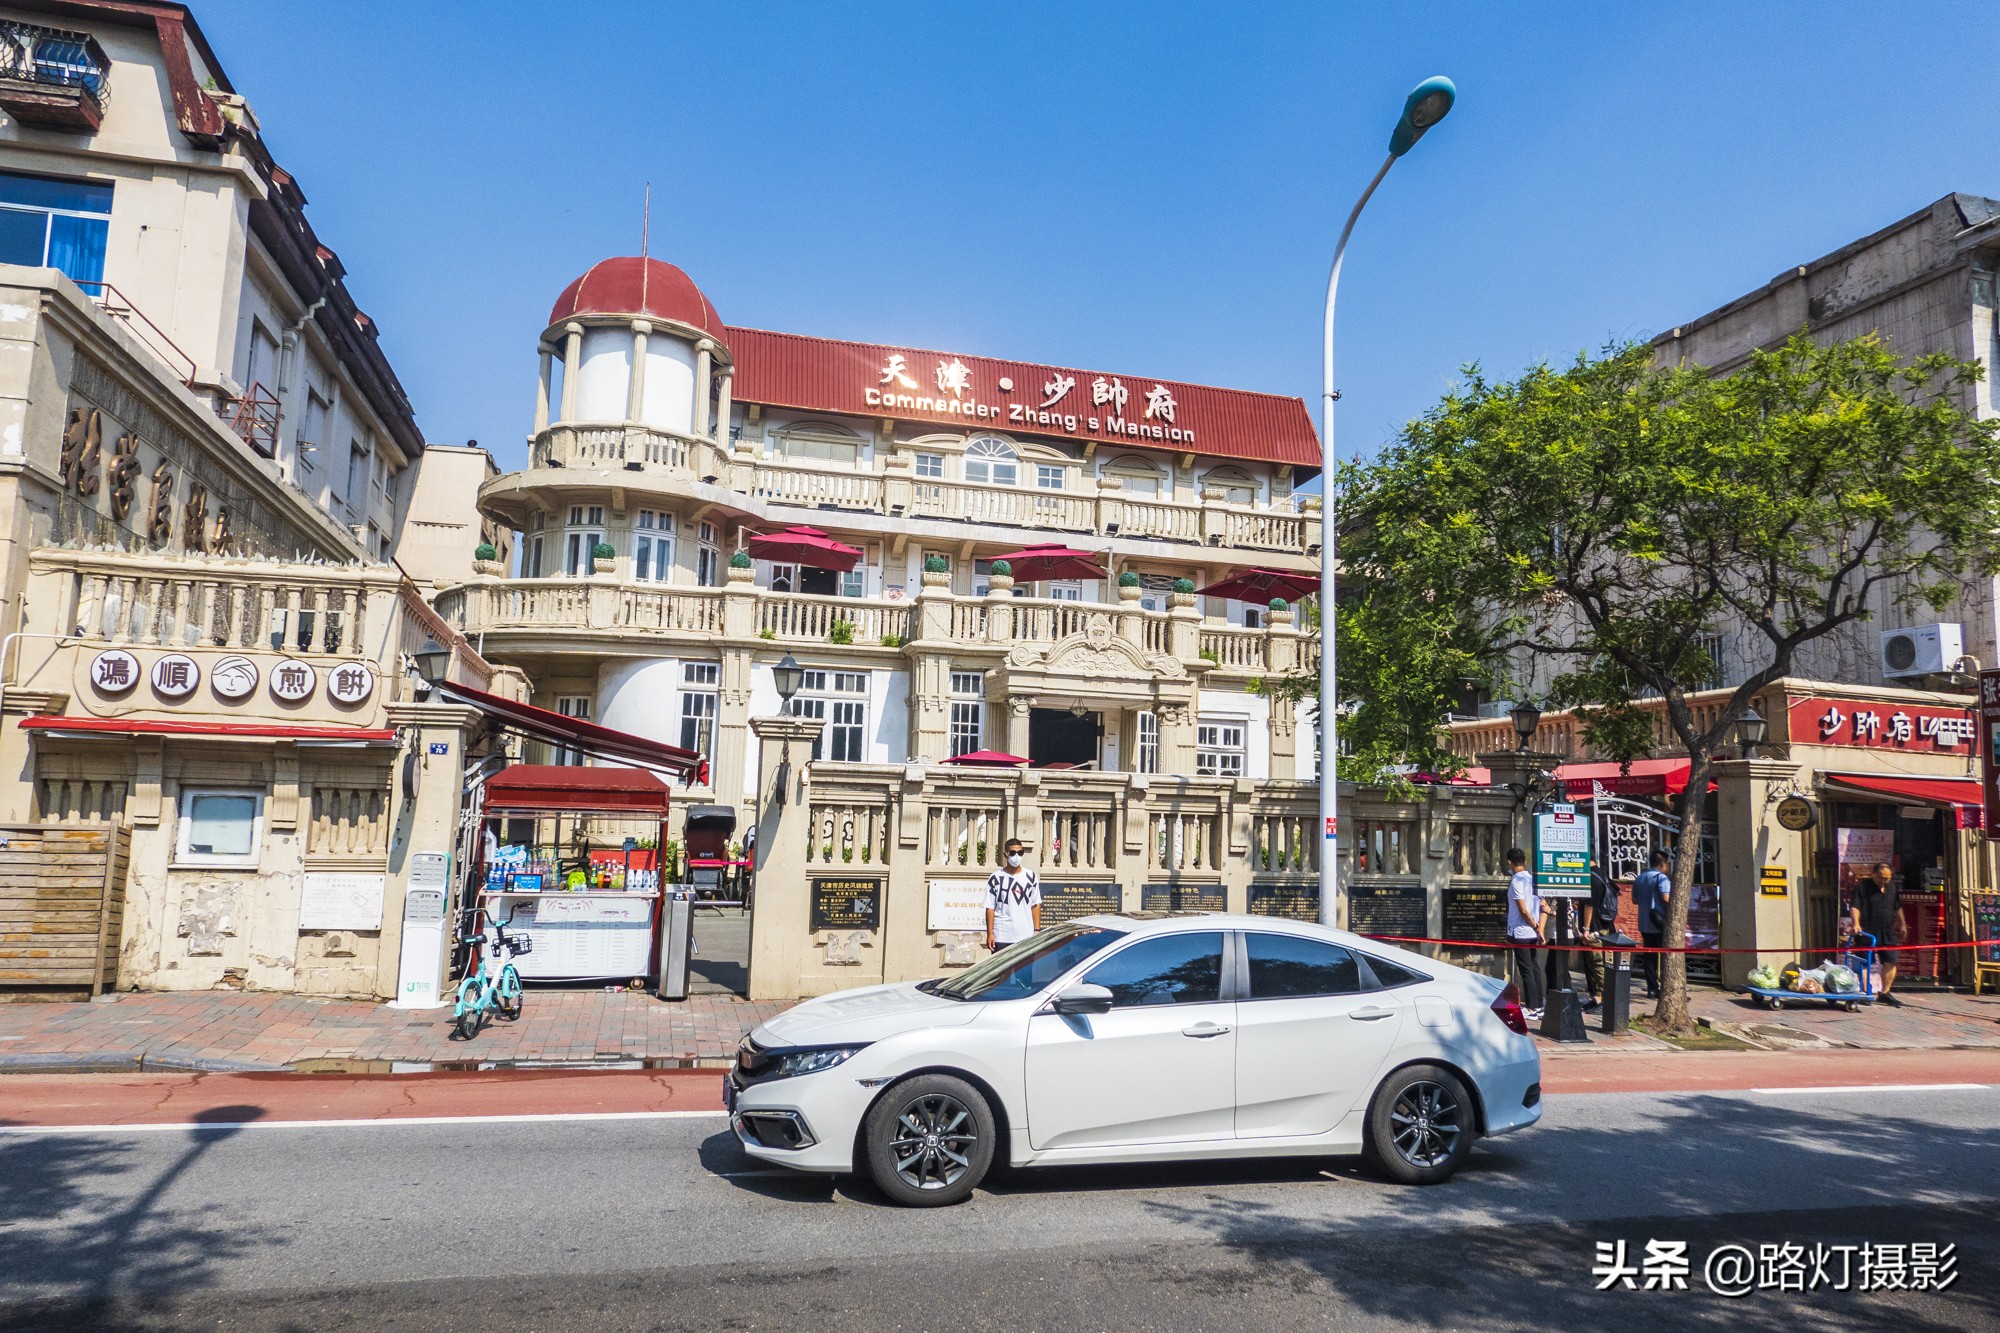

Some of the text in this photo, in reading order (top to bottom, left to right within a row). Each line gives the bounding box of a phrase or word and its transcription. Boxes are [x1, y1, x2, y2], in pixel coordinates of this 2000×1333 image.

[865, 387, 1195, 442] Commander Zhang's Mansion
